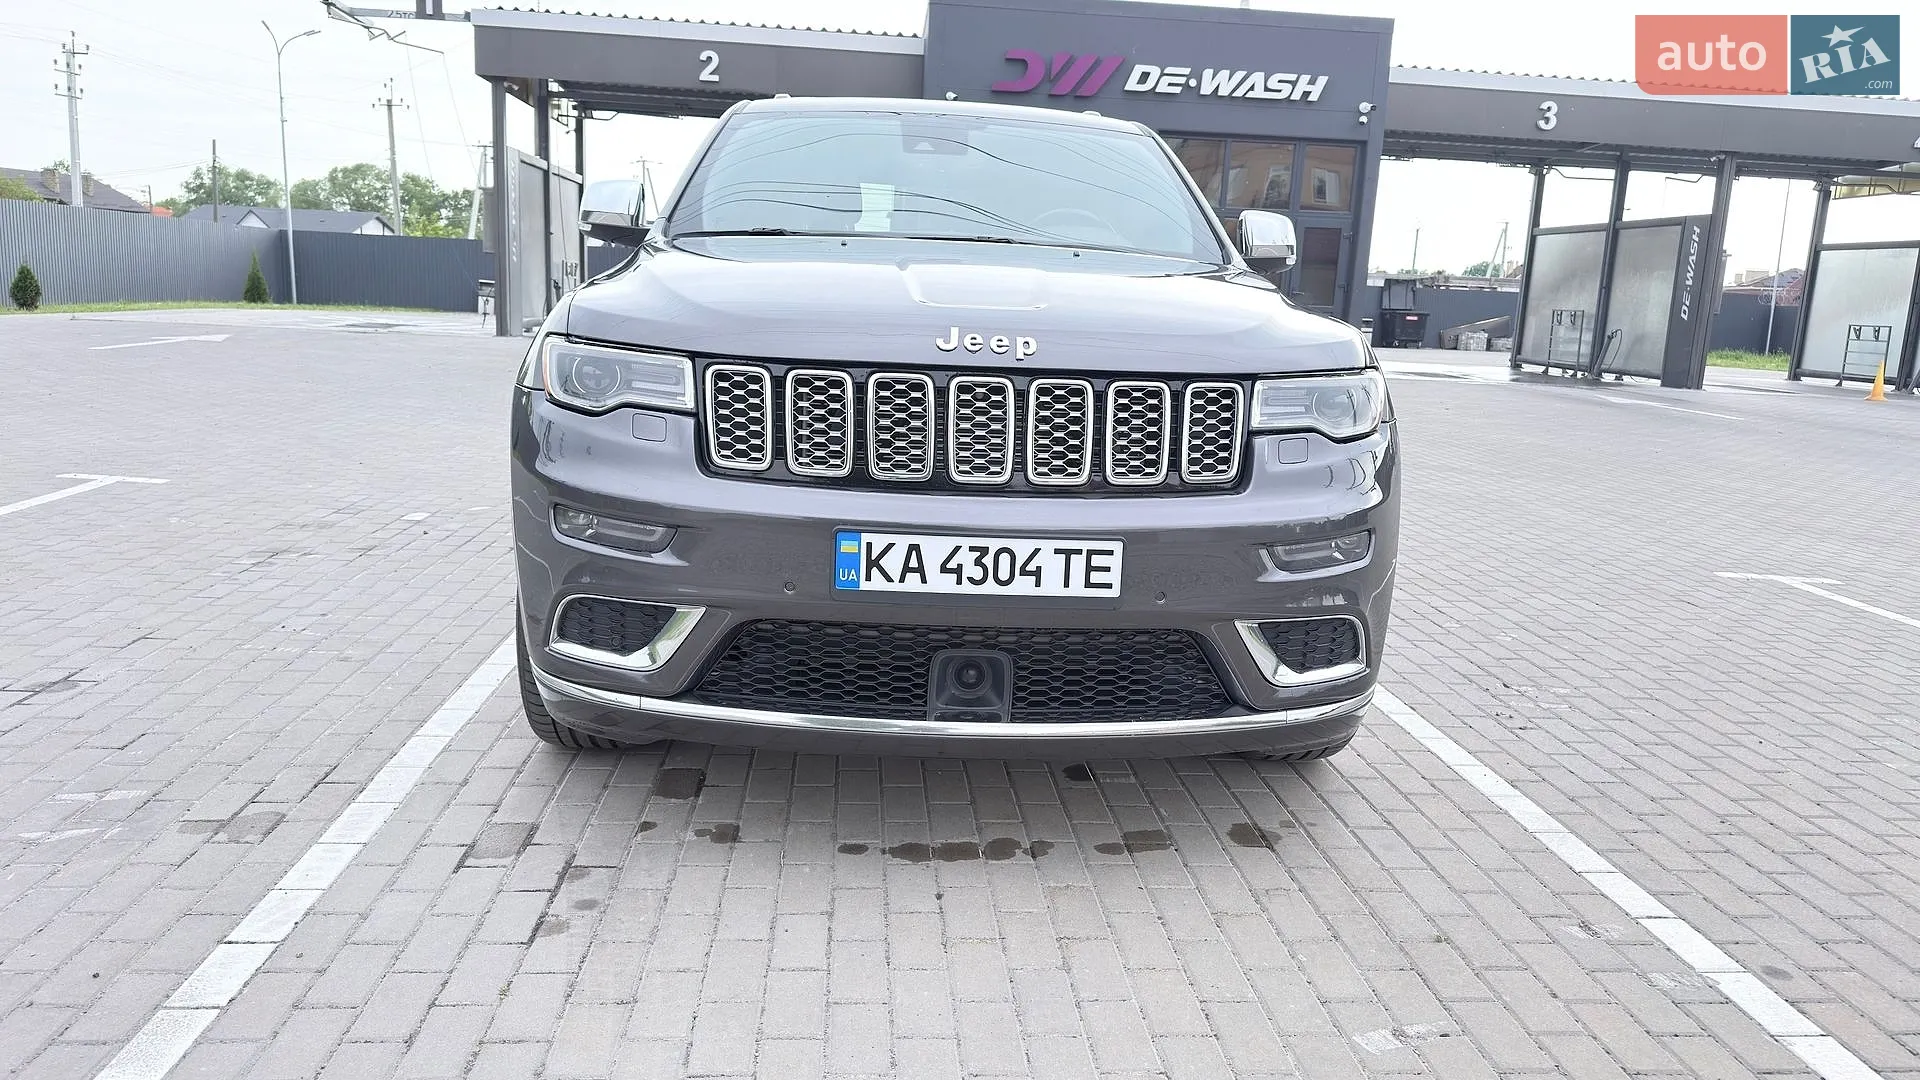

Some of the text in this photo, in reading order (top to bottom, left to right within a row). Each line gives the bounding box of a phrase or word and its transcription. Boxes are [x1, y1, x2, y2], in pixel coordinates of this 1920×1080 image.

[699, 50, 720, 82] 2
[1536, 100, 1558, 131] 3
[935, 326, 1038, 361] Jeep
[839, 541, 1114, 590] UA KA 4304 TE
